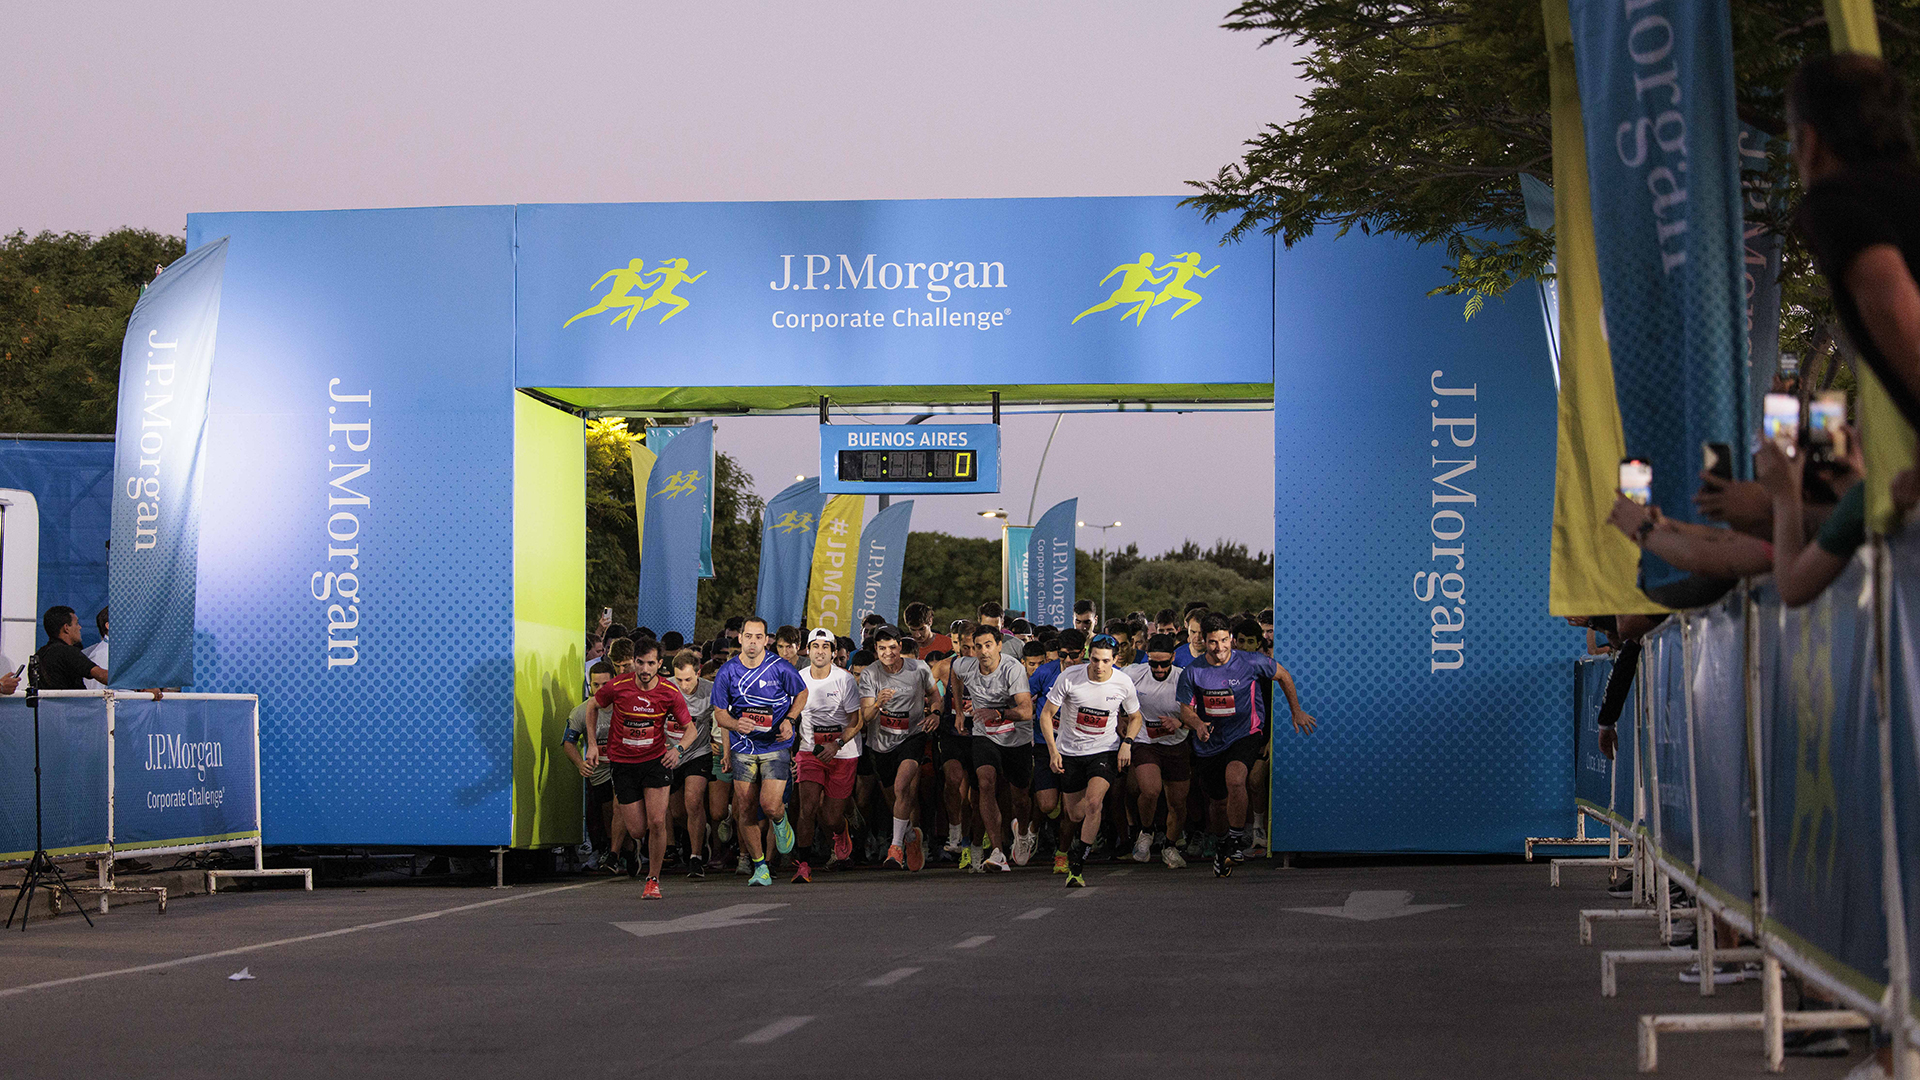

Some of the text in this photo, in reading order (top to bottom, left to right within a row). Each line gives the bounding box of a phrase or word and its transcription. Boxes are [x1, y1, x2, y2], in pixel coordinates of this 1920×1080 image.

[1616, 0, 1688, 276] organ
[770, 254, 1008, 303] J.P.Morgan
[771, 309, 885, 332] Corporate
[126, 329, 178, 552] J.P.Morgan
[847, 432, 968, 447] BUENOS AIRES
[311, 377, 372, 671] J.P.Morgan
[1413, 370, 1477, 674] J.P.Morgan
[818, 517, 849, 627] #JPMCC
[1036, 538, 1046, 588] Corporate
[1209, 697, 1227, 706] 954
[748, 714, 765, 723] 960
[886, 718, 902, 726] 577
[1083, 715, 1101, 724] 837
[630, 728, 647, 737] 295
[822, 734, 833, 742] 12
[145, 733, 223, 782] J.P.Morgan
[147, 790, 186, 812] Corporate
